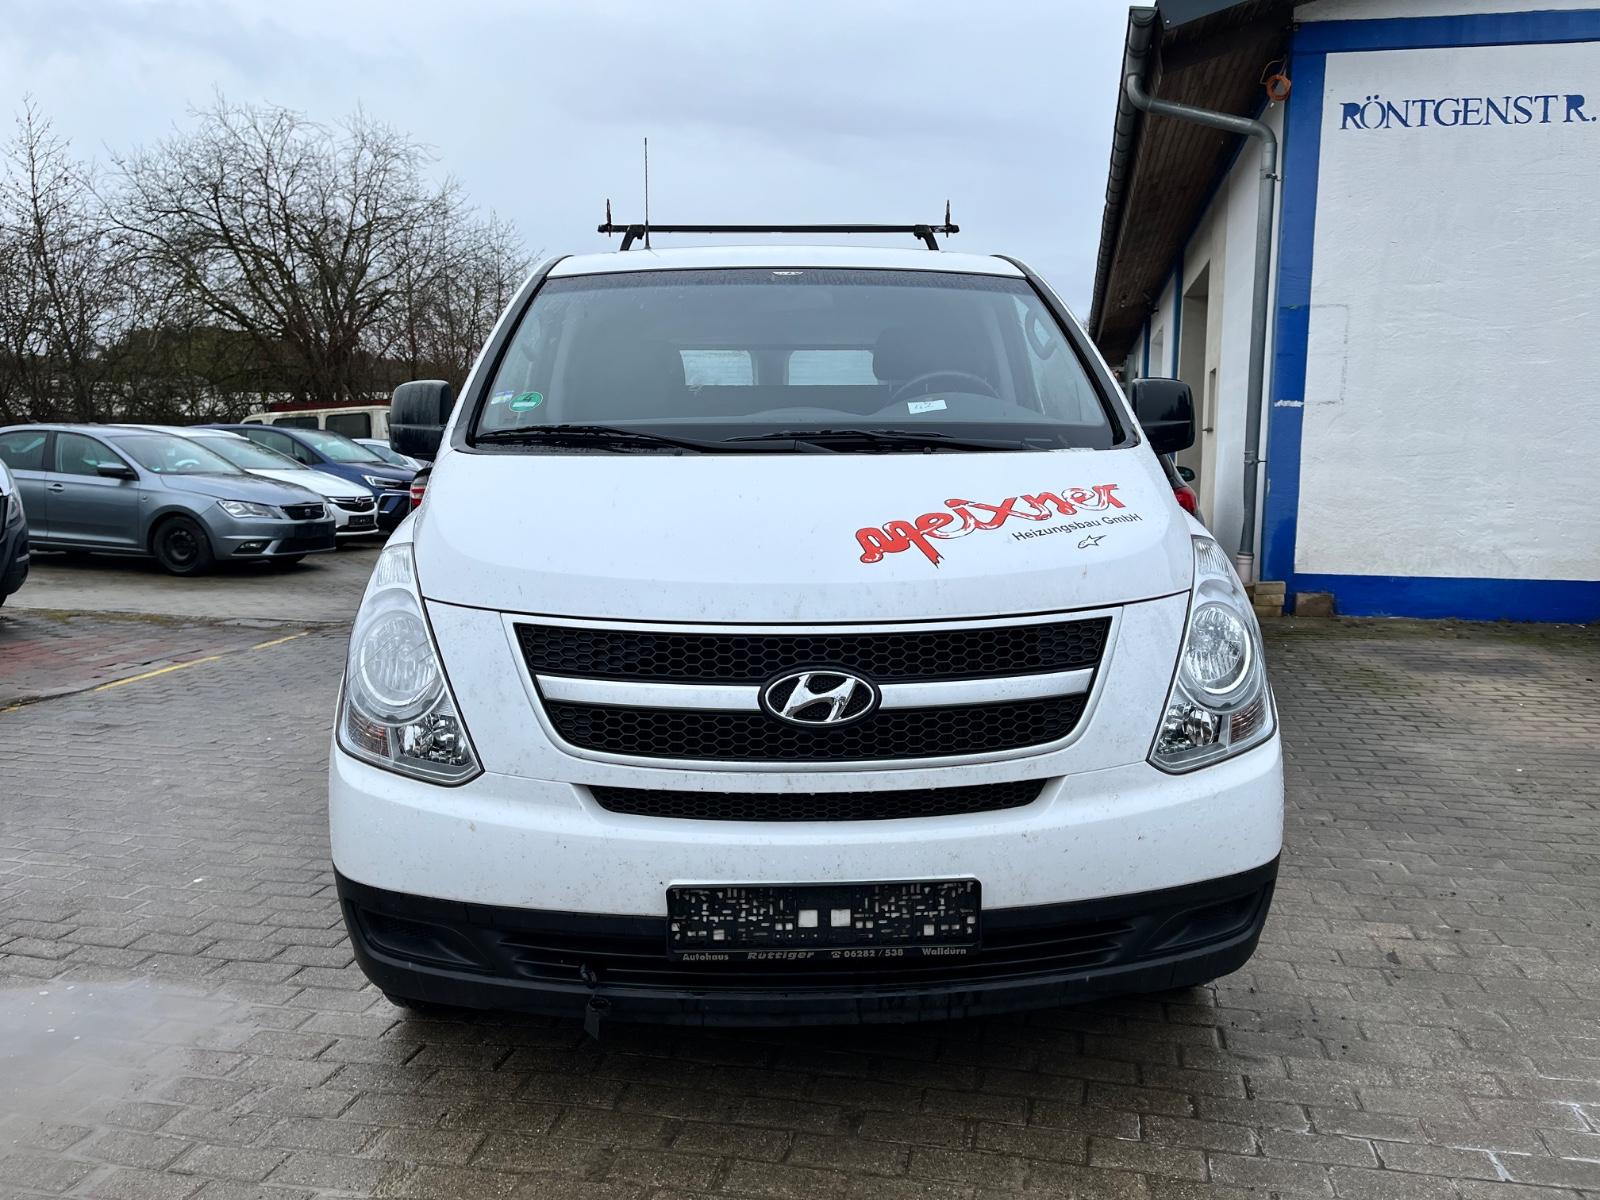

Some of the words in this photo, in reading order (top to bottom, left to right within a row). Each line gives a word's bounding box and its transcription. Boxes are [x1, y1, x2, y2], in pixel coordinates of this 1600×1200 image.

[1011, 519, 1102, 541] Heizungsbau
[1101, 512, 1143, 525] GmbH
[682, 952, 729, 961] Autohaus
